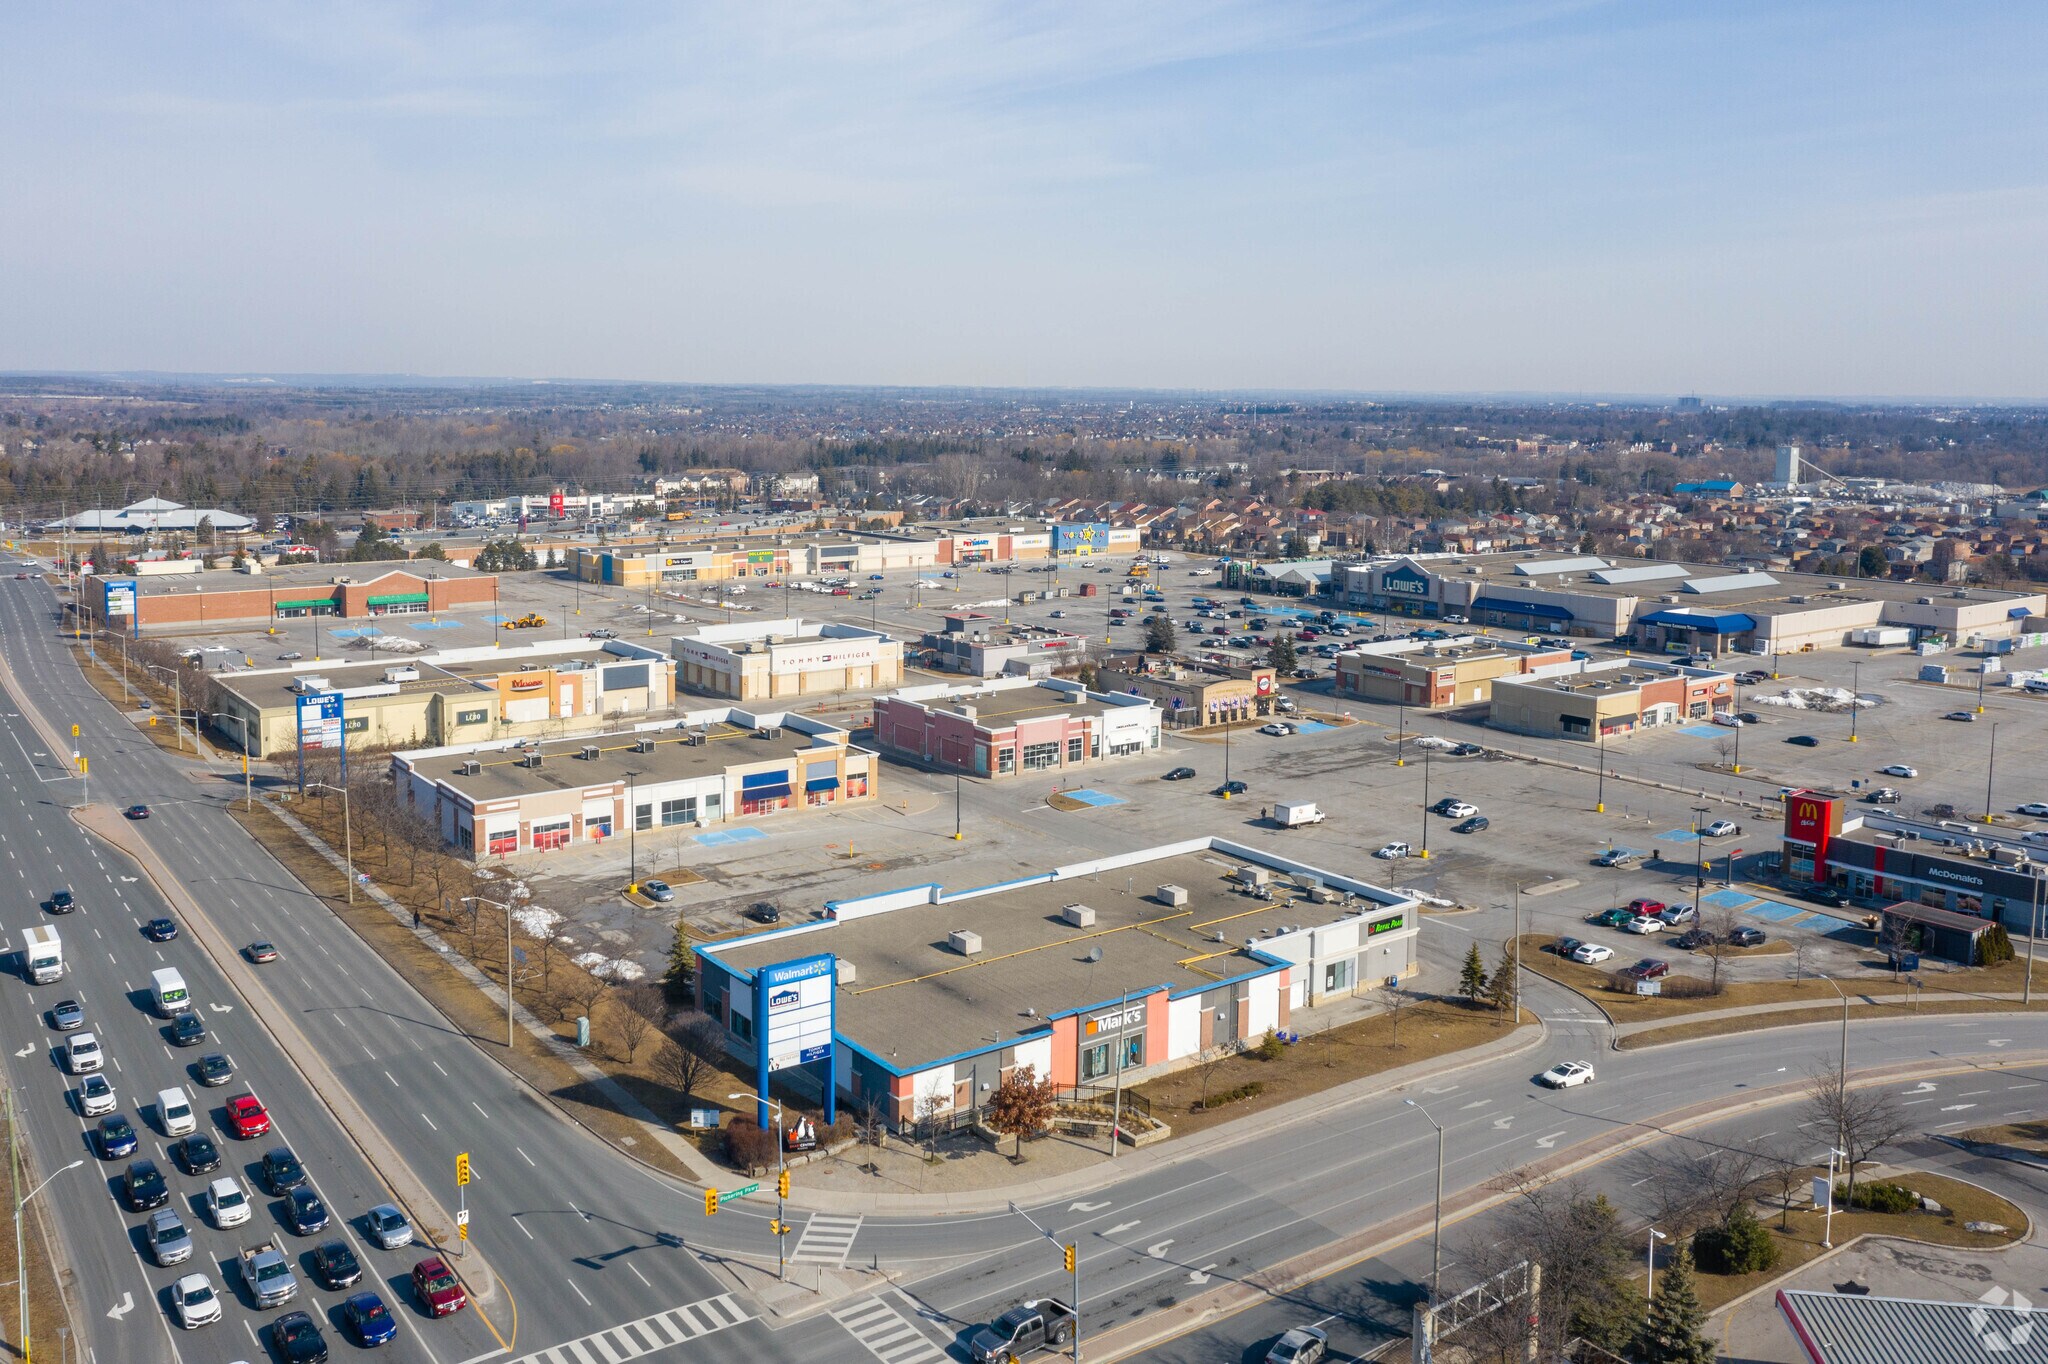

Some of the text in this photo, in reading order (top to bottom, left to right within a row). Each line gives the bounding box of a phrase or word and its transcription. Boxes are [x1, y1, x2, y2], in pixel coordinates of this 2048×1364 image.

[1386, 577, 1424, 593] LOWE'S
[782, 651, 870, 665] TOMMY HILFIGER
[306, 695, 335, 705] LOWE'S
[1928, 867, 1983, 885] McDonald's
[774, 965, 814, 982] Walmart
[771, 992, 798, 1006] LOWE'S
[720, 1191, 743, 1202] Pickering
